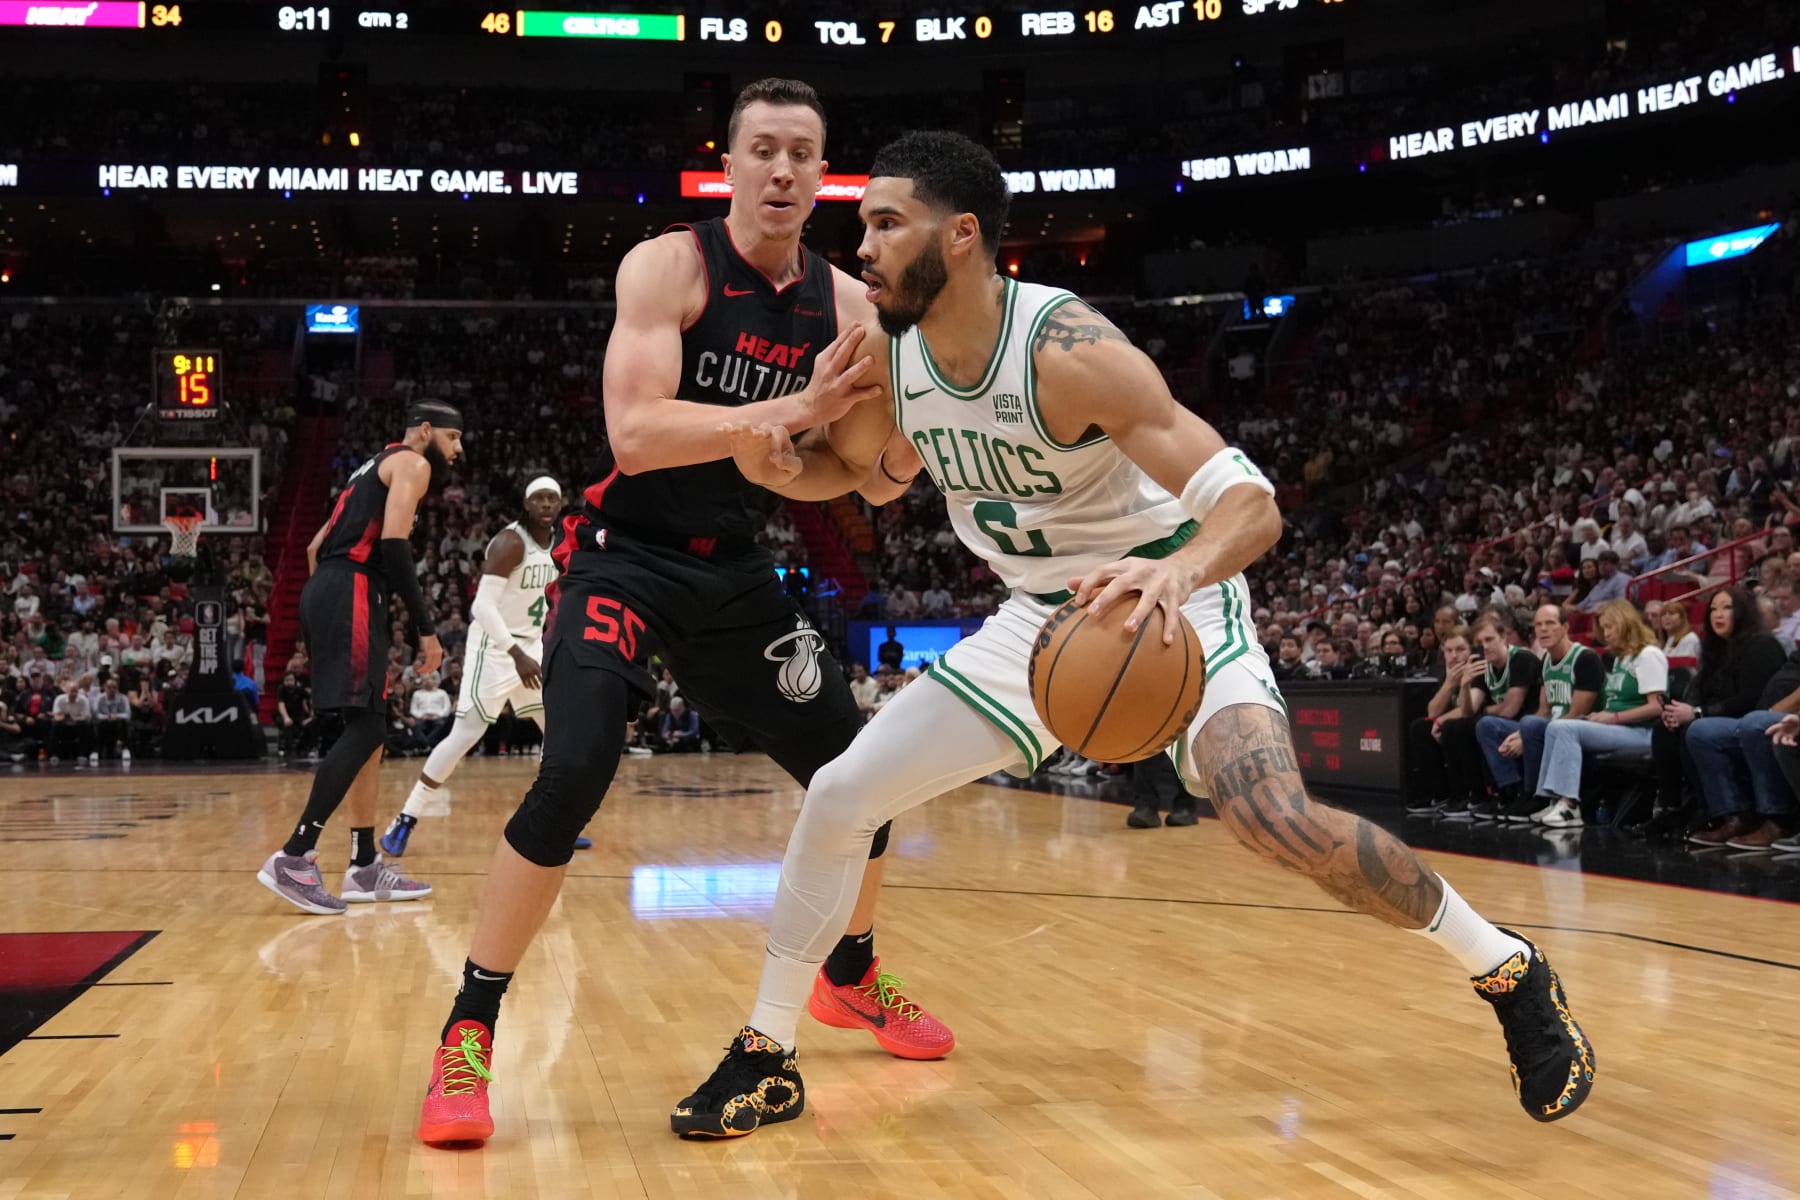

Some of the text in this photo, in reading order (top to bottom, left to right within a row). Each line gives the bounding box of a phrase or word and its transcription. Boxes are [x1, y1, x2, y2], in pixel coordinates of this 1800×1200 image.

[151, 5, 182, 26] 34
[278, 6, 330, 30] 9:11
[358, 12, 408, 29] QTR 2
[481, 12, 639, 35] 46 CELTICS
[1021, 10, 1114, 36] REB 16
[1134, 0, 1222, 30] AST 10
[700, 17, 782, 43] FLS 0
[814, 21, 896, 45] TOL 7
[916, 16, 993, 41] BLK 0
[1389, 127, 1454, 161] HEAR
[1461, 109, 1540, 148] EVERY
[1546, 92, 1629, 132] MIAMI
[1637, 76, 1702, 115] HEAT
[1707, 53, 1785, 98] GAME.
[1234, 147, 1311, 176] WOAM
[99, 165, 579, 195] HEAR EVERY MIAMI HEAT GAME. LIVE
[815, 183, 867, 199] udacy
[1039, 168, 1116, 191] WOAM
[735, 331, 812, 369] HEAT
[173, 354, 214, 375] 9:11
[696, 351, 808, 400] CULTU
[181, 373, 209, 405] 15
[176, 408, 219, 419] TISSOT
[993, 392, 1022, 412] VISTA
[995, 410, 1024, 424] PRINT
[912, 427, 1063, 498] CELTICS
[520, 564, 556, 589] CELTI
[527, 595, 545, 627] 4
[199, 628, 217, 642] GET
[200, 643, 218, 658] THE
[199, 658, 218, 674] APP
